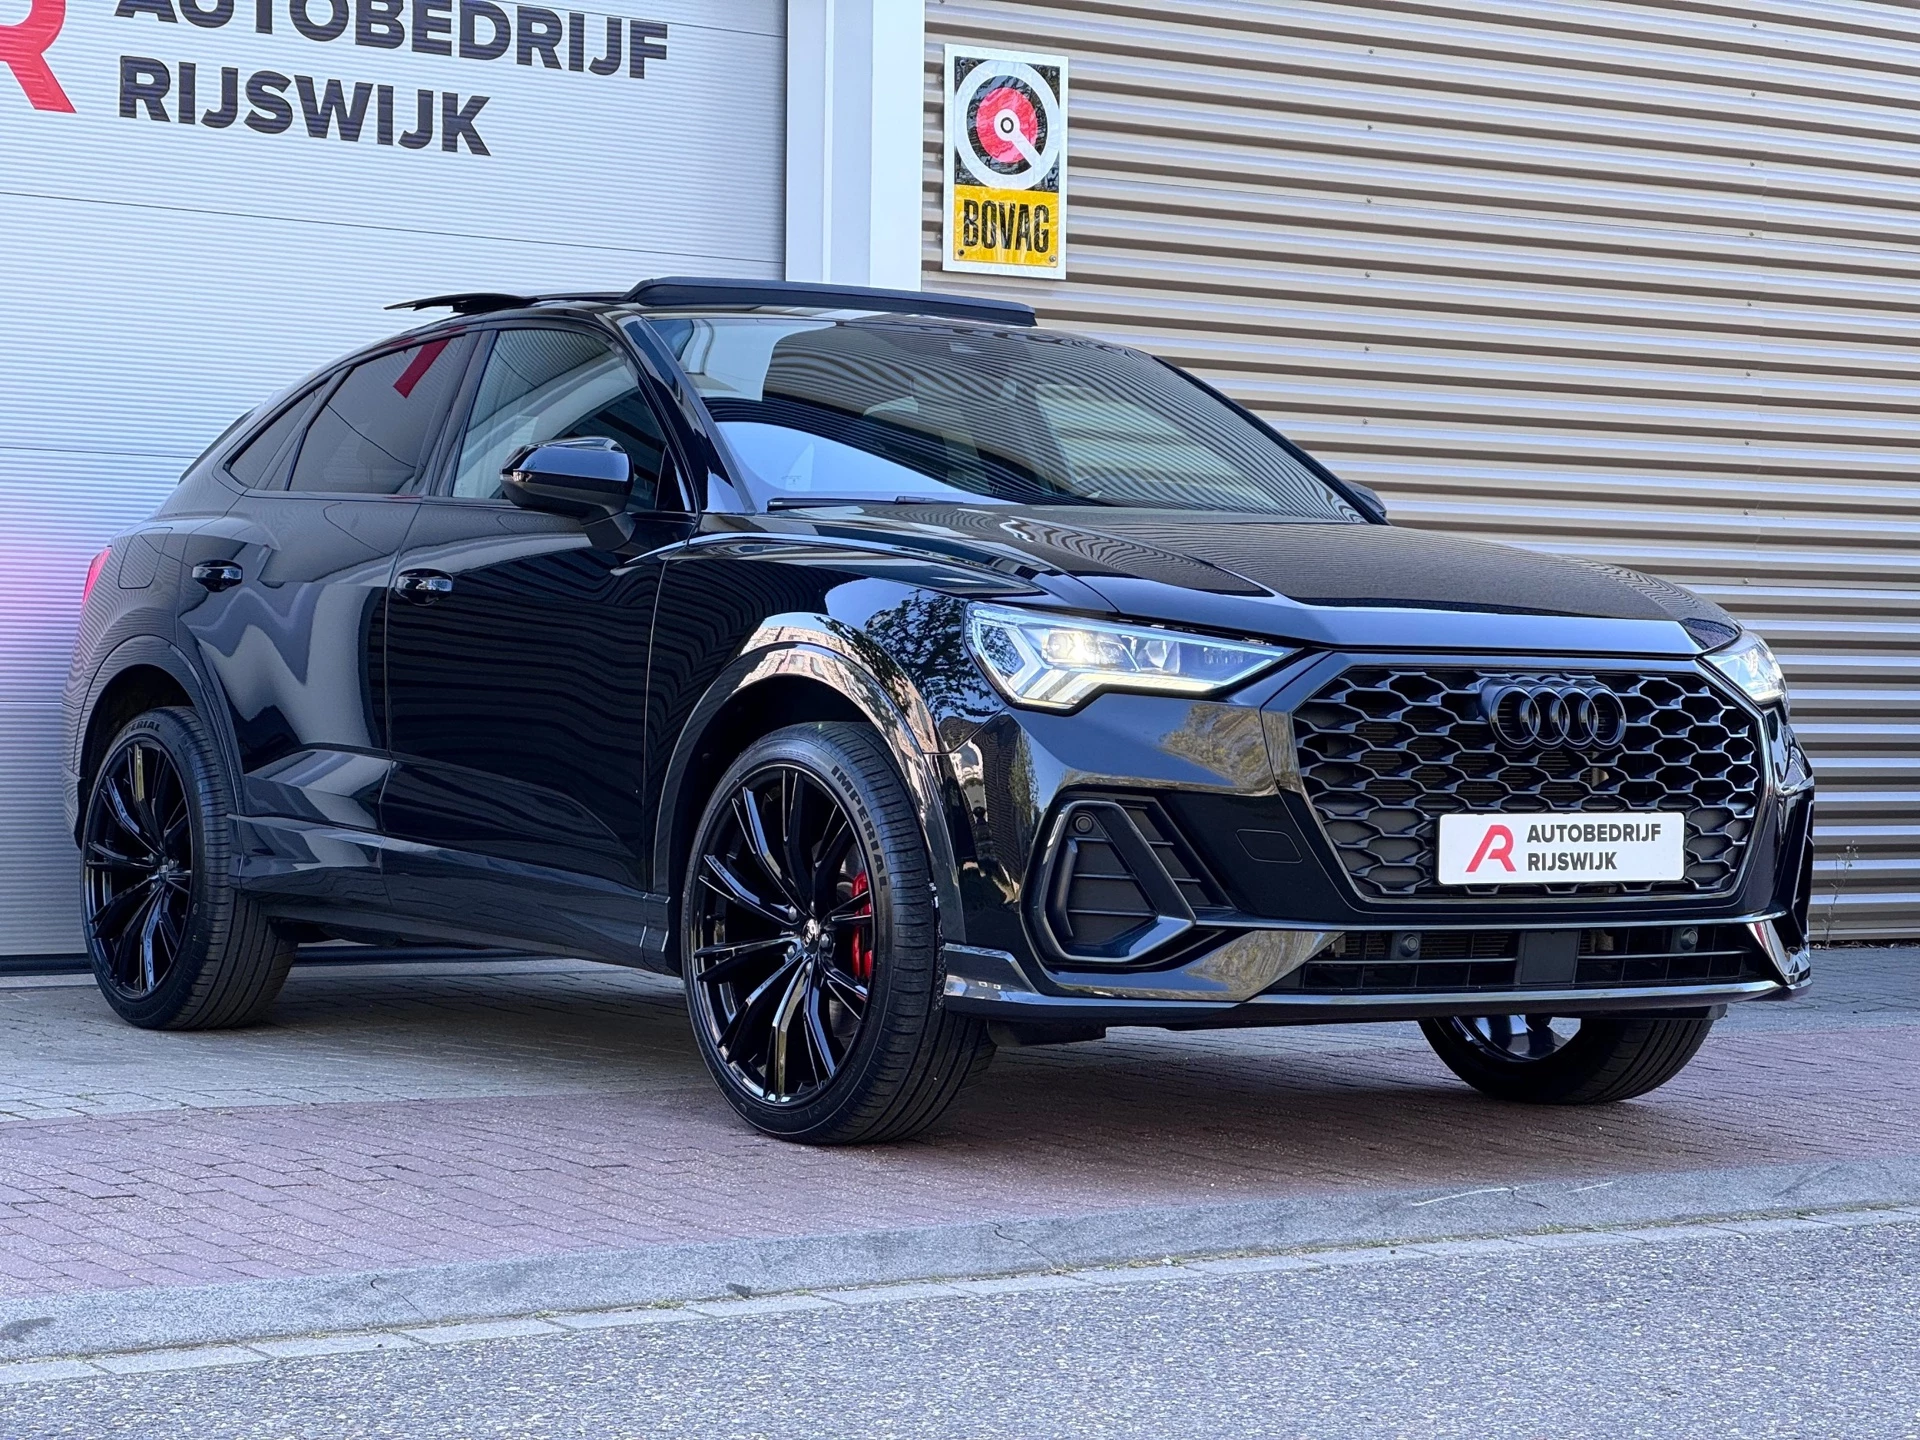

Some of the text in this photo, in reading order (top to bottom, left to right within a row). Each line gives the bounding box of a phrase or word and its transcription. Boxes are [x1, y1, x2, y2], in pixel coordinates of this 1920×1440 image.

[119, 55, 491, 156] RIJSWIJK
[963, 199, 1050, 253] BOVAG
[831, 766, 887, 891] IMPERIAL
[1526, 823, 1661, 843] AUTOBEDRIJF
[1527, 851, 1618, 872] RIJSWIJK
